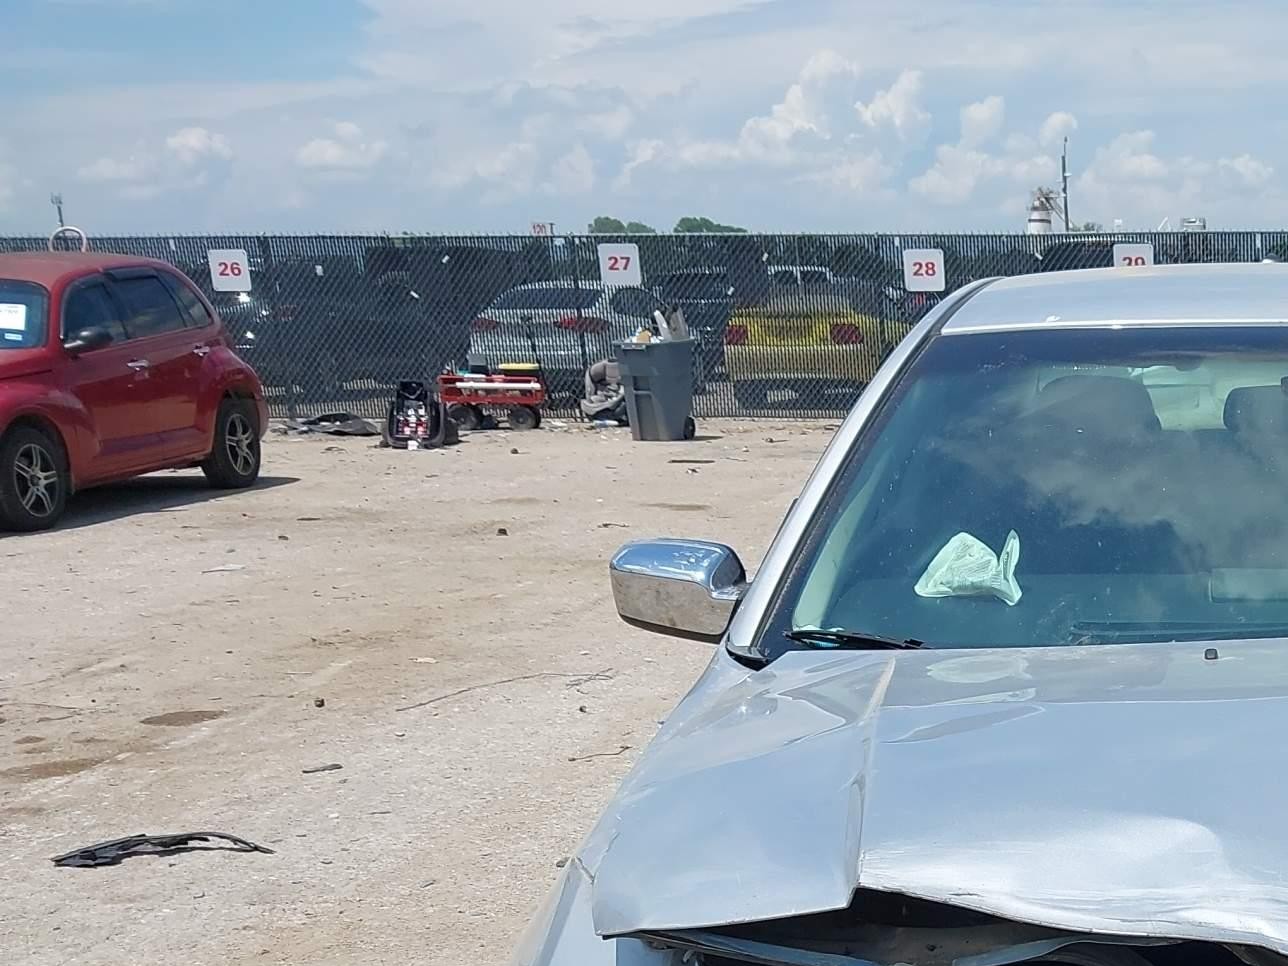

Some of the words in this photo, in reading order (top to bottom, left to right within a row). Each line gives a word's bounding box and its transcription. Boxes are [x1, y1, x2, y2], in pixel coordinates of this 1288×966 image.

[218, 261, 242, 276] 26
[607, 256, 631, 271] 27
[912, 261, 936, 277] 28
